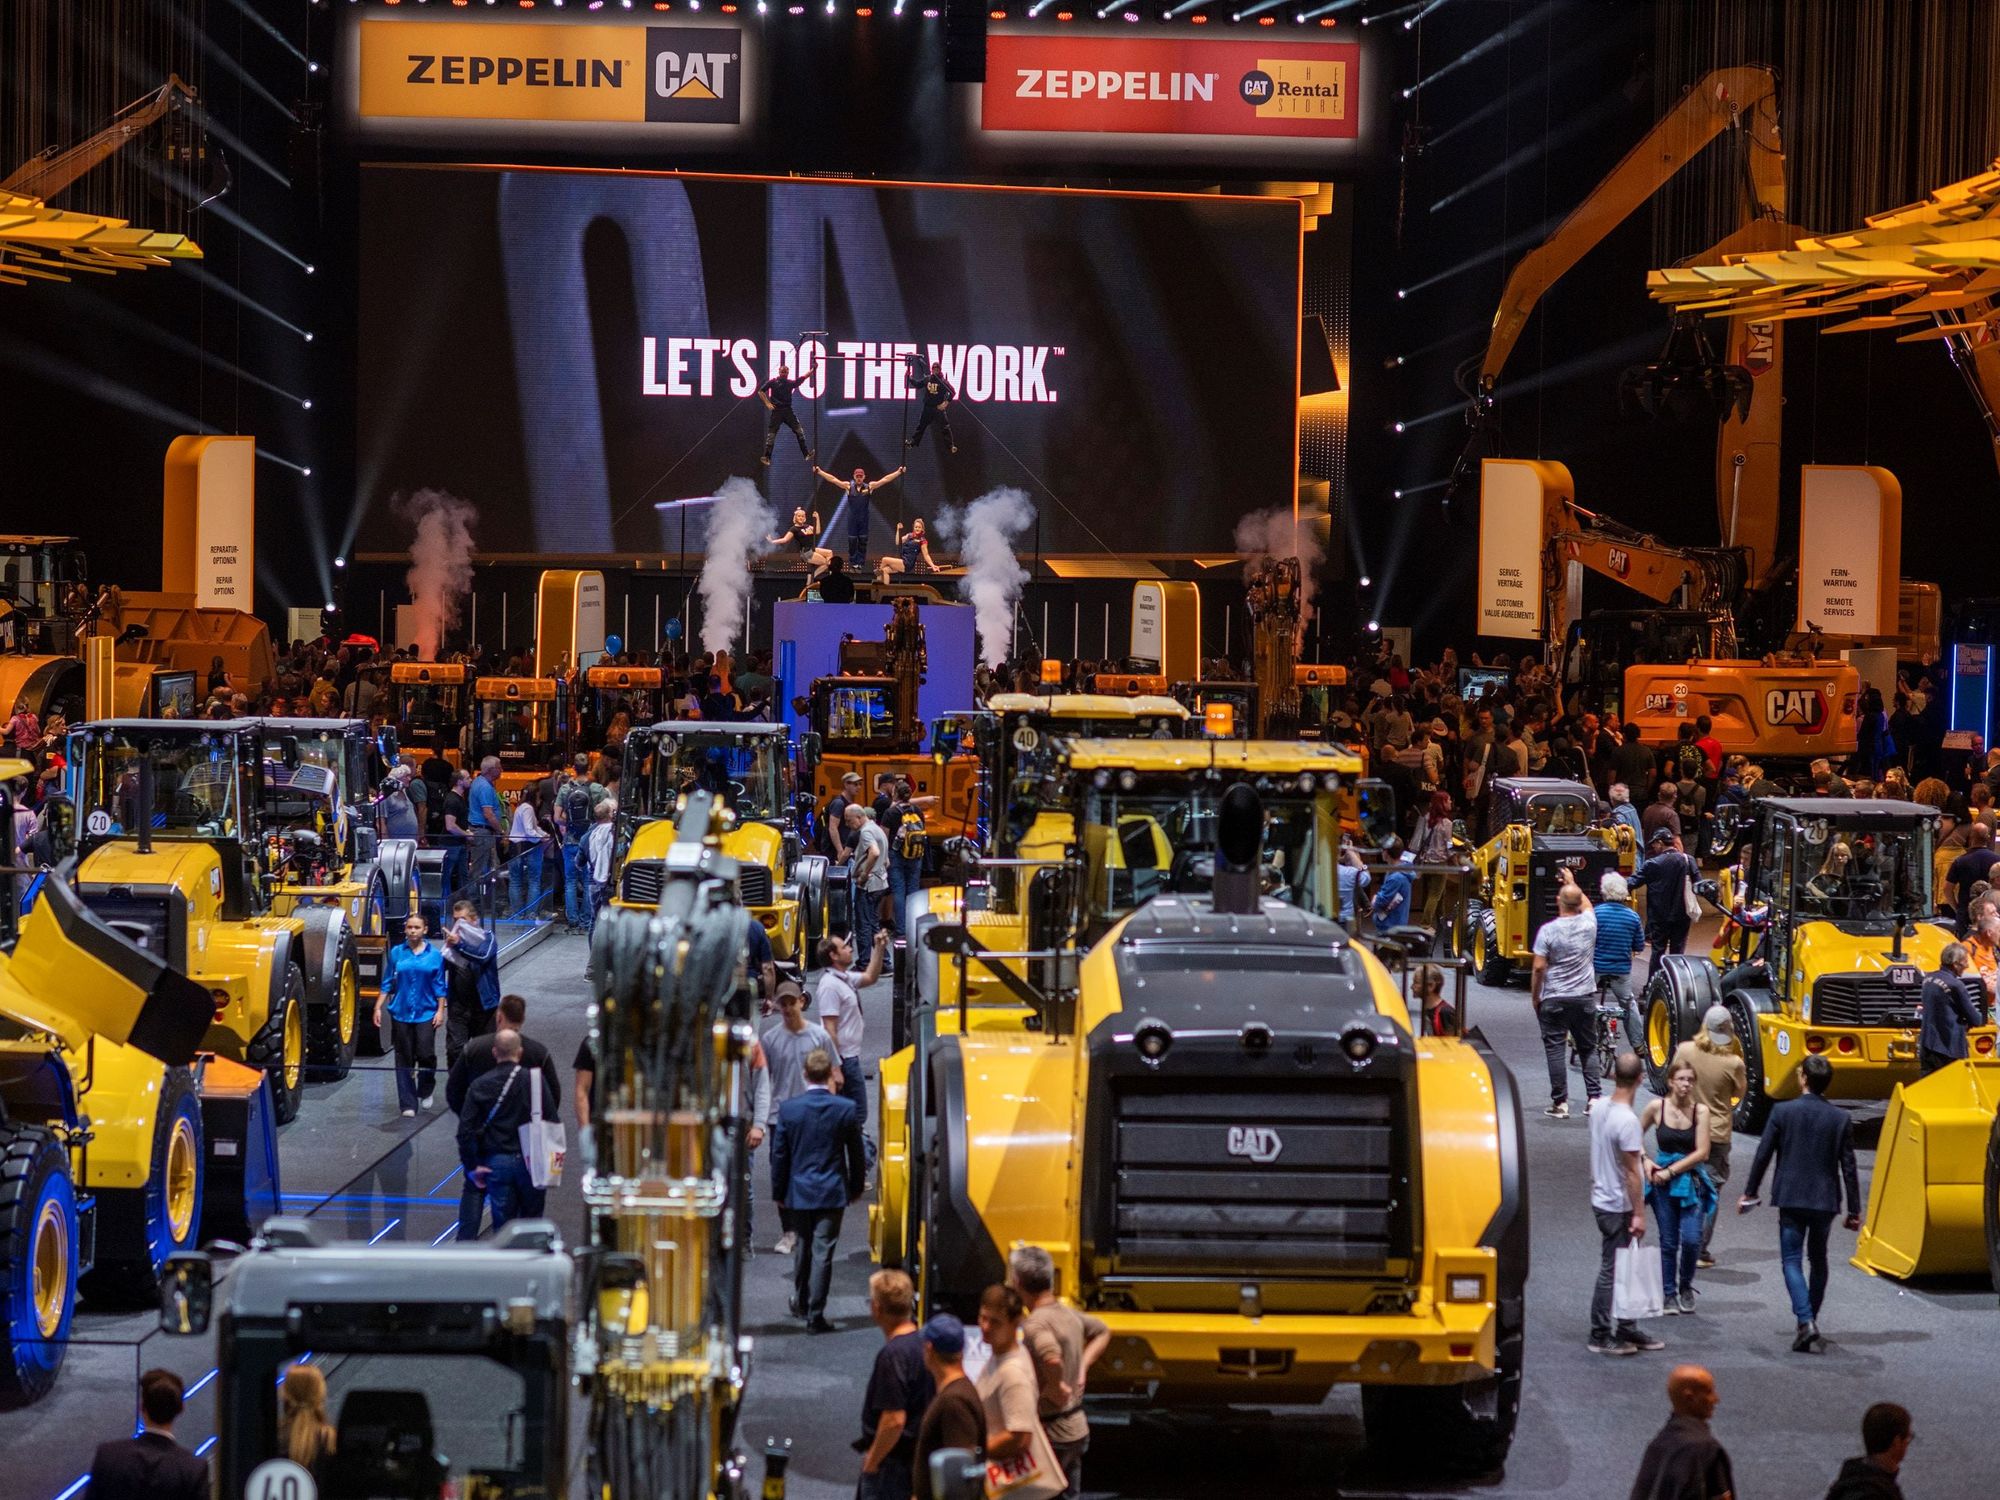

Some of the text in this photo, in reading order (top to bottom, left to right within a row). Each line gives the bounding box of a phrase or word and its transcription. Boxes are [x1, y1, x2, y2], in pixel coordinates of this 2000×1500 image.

[407, 54, 622, 88] ZEPPELIN
[655, 51, 730, 98] CAT
[1015, 69, 1213, 102] ZEPPELIN
[1244, 80, 1268, 96] CAT
[1277, 81, 1339, 97] Rental
[1746, 319, 1774, 363] CAT
[642, 336, 1058, 402] LET'S DO THE WORK.
[210, 545, 238, 553] REPARATUR-
[213, 556, 236, 564] OPTIONEN
[1608, 548, 1628, 573] CAT
[216, 576, 232, 584] REPAIR
[1498, 568, 1522, 577] SERVICE-
[1830, 568, 1850, 577] FERN-
[214, 587, 234, 595] OPTIONS
[1823, 579, 1857, 588] WARTUNG
[1495, 598, 1524, 608] CUSTOMER
[1825, 597, 1853, 606] REMOTE
[1484, 608, 1535, 620] VALUE AGREEMENTS
[1823, 607, 1855, 617] SERVICES
[1675, 685, 1687, 695] 20
[1645, 694, 1670, 710] CAT
[1767, 689, 1816, 725] CAT
[1018, 730, 1034, 747] 40
[92, 815, 107, 831] 20
[1809, 823, 1824, 840] 20
[1565, 856, 1582, 867] CAT
[1892, 968, 1916, 984] CAT
[1227, 1126, 1276, 1157] CAT
